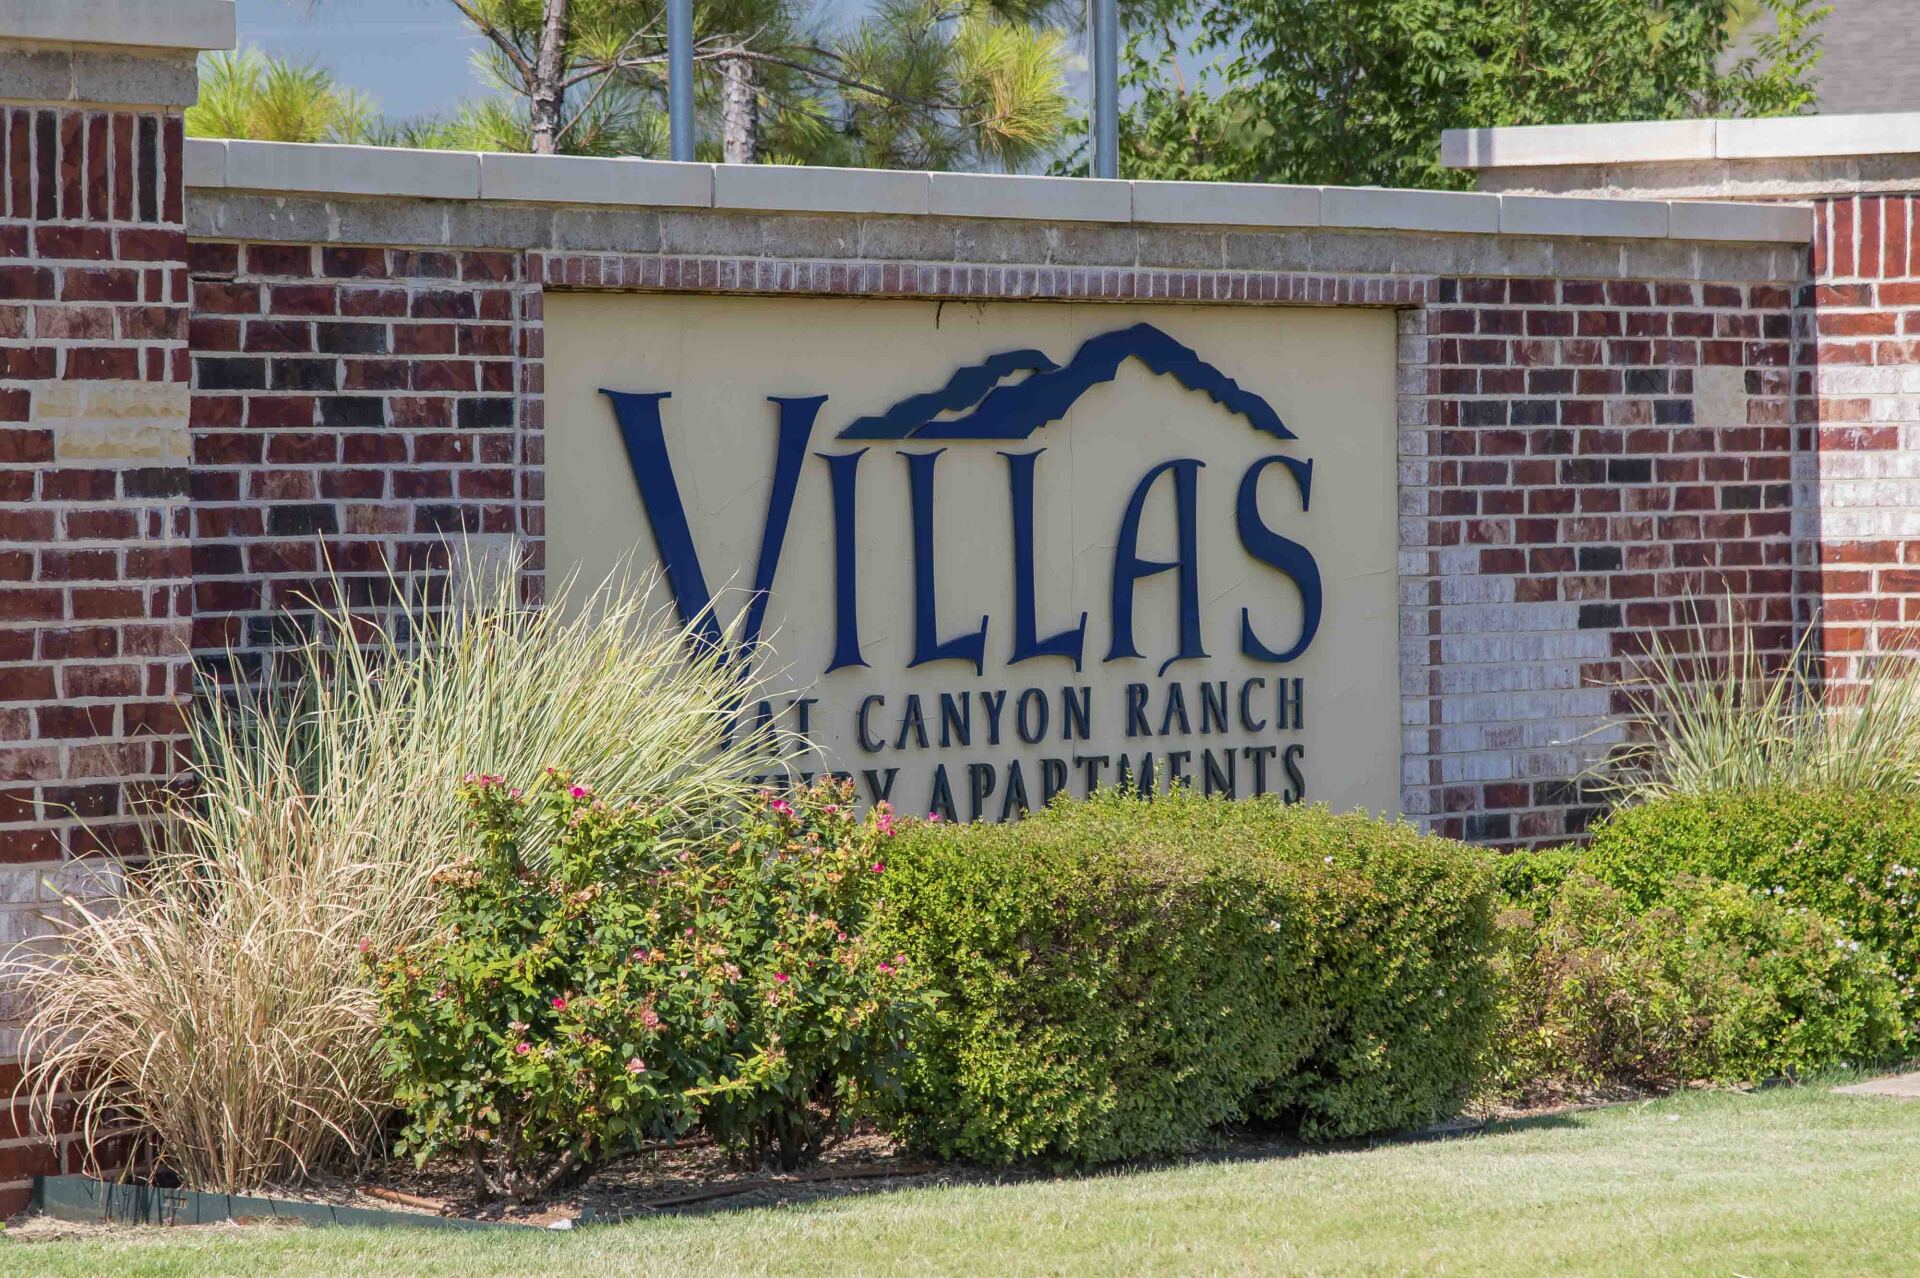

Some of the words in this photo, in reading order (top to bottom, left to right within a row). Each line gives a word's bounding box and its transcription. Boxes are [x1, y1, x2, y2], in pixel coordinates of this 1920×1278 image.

[598, 387, 1323, 752] VILLAS
[747, 698, 819, 757] AT
[857, 687, 1092, 753] CANYON
[1125, 677, 1304, 737] RANCH
